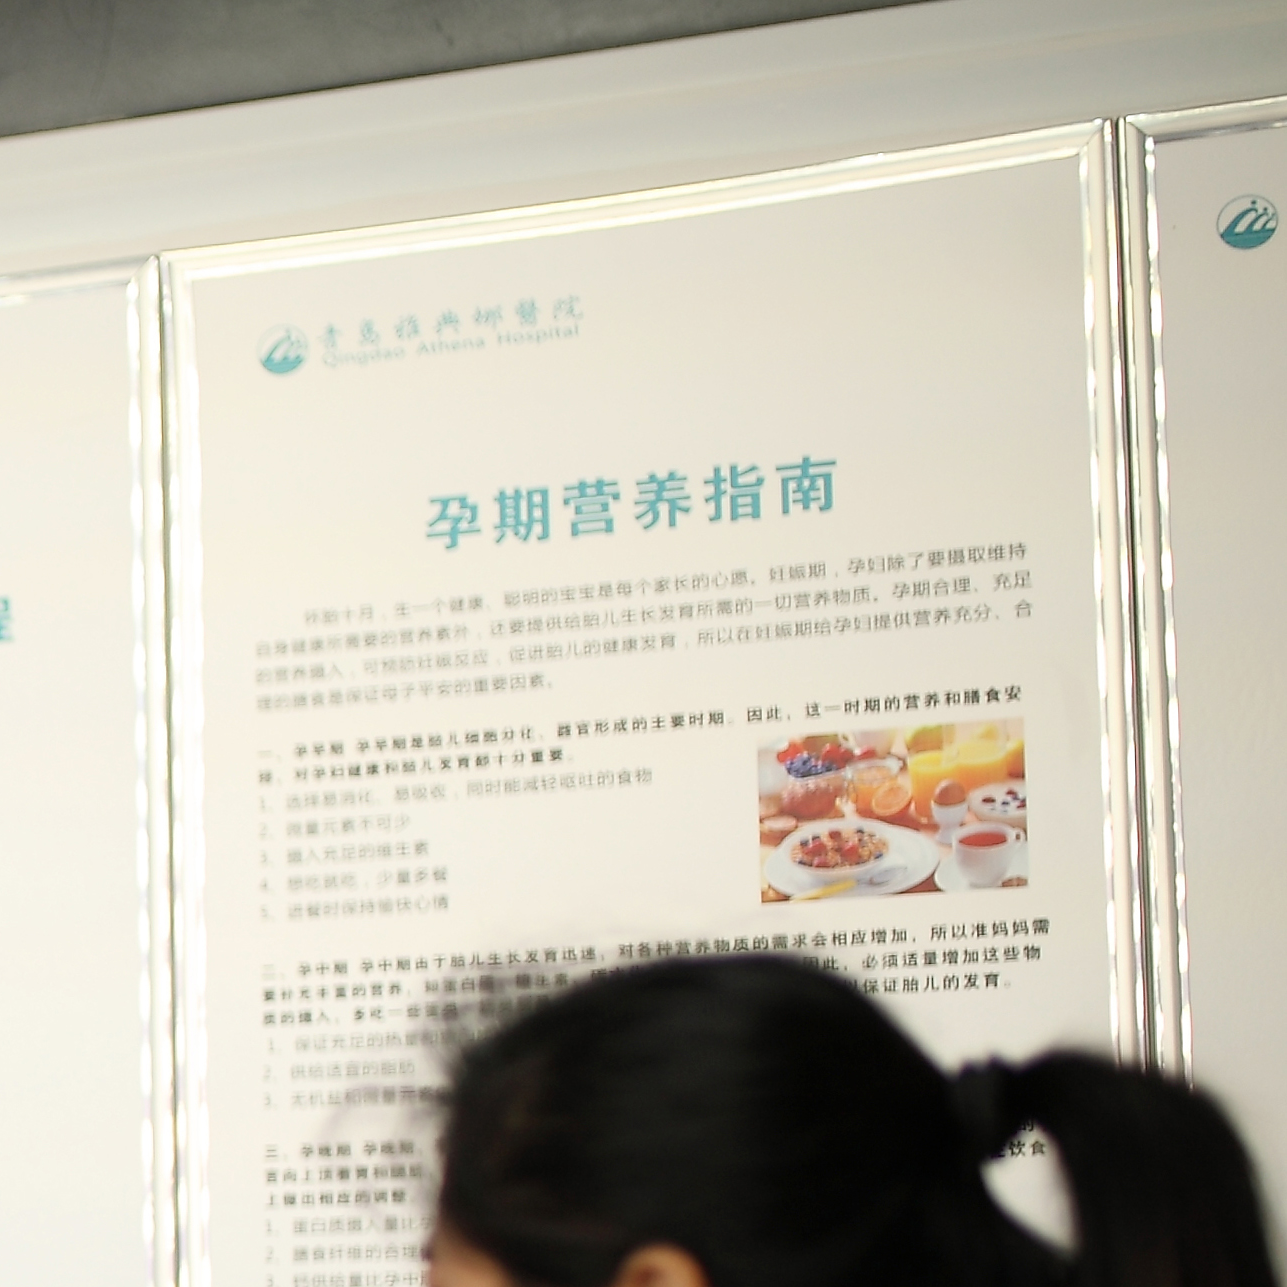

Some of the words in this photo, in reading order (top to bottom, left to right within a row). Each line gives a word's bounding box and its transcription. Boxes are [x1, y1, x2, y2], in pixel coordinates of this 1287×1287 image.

[496, 325, 580, 347] Hospital
[425, 455, 837, 550] 孕期营养指南
